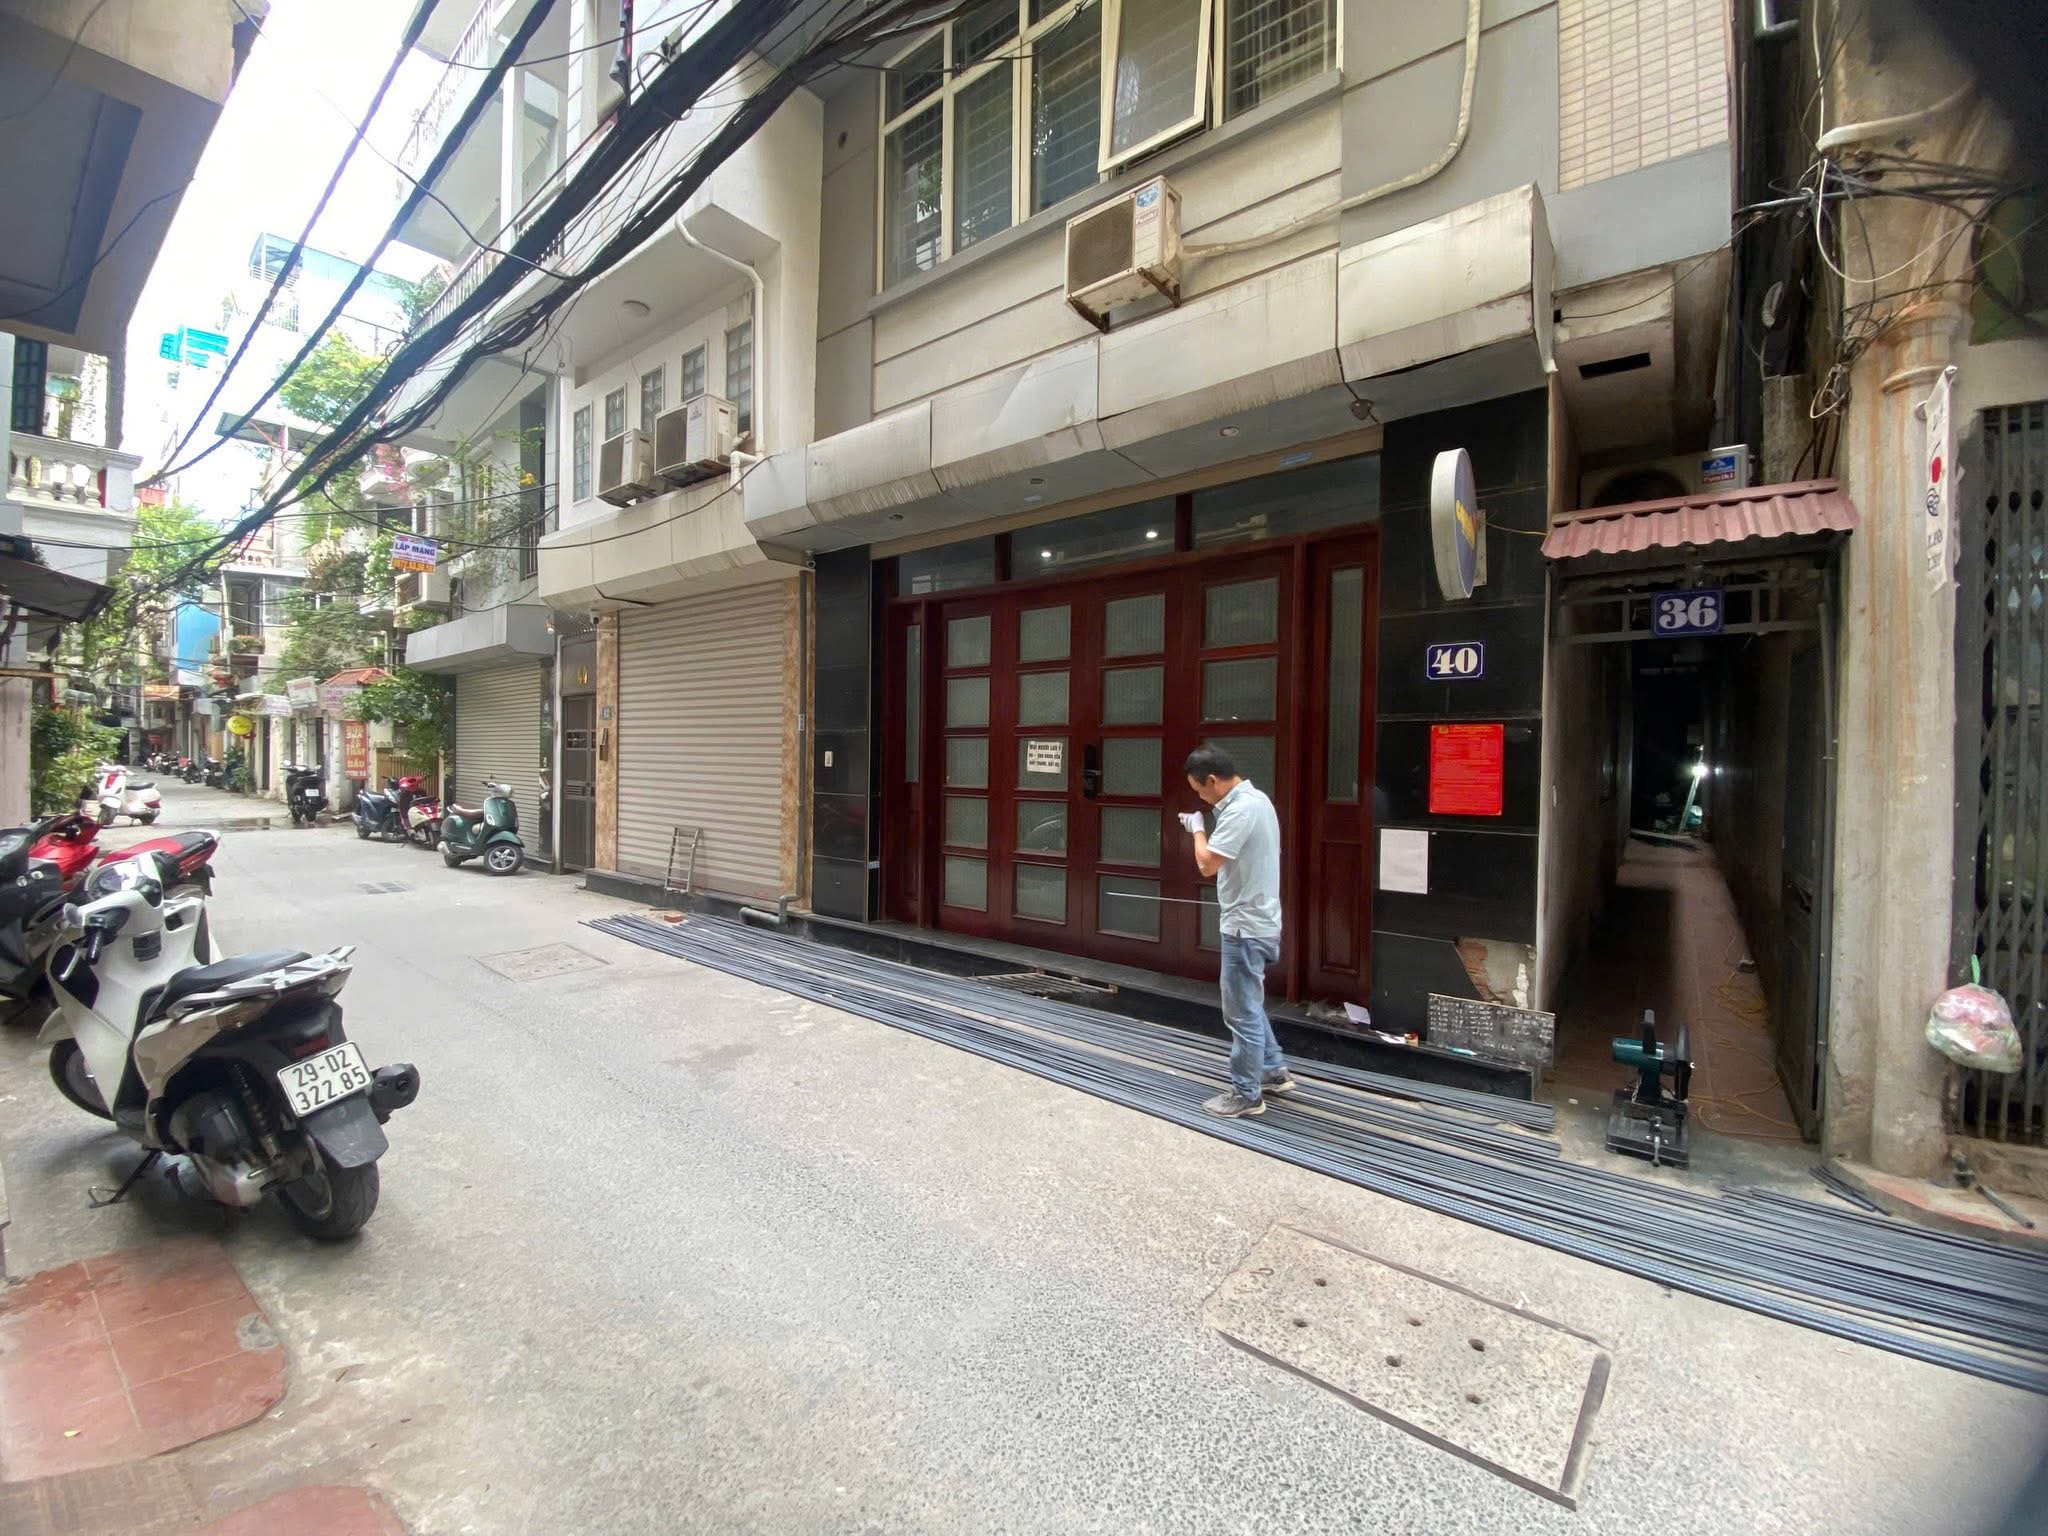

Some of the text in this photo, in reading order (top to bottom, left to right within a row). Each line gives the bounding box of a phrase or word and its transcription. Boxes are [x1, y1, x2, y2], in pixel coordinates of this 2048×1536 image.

[1658, 595, 1718, 629] 36
[1431, 647, 1478, 674] 40
[292, 1049, 352, 1087] 29-D2
[296, 1066, 366, 1110] 322.85
